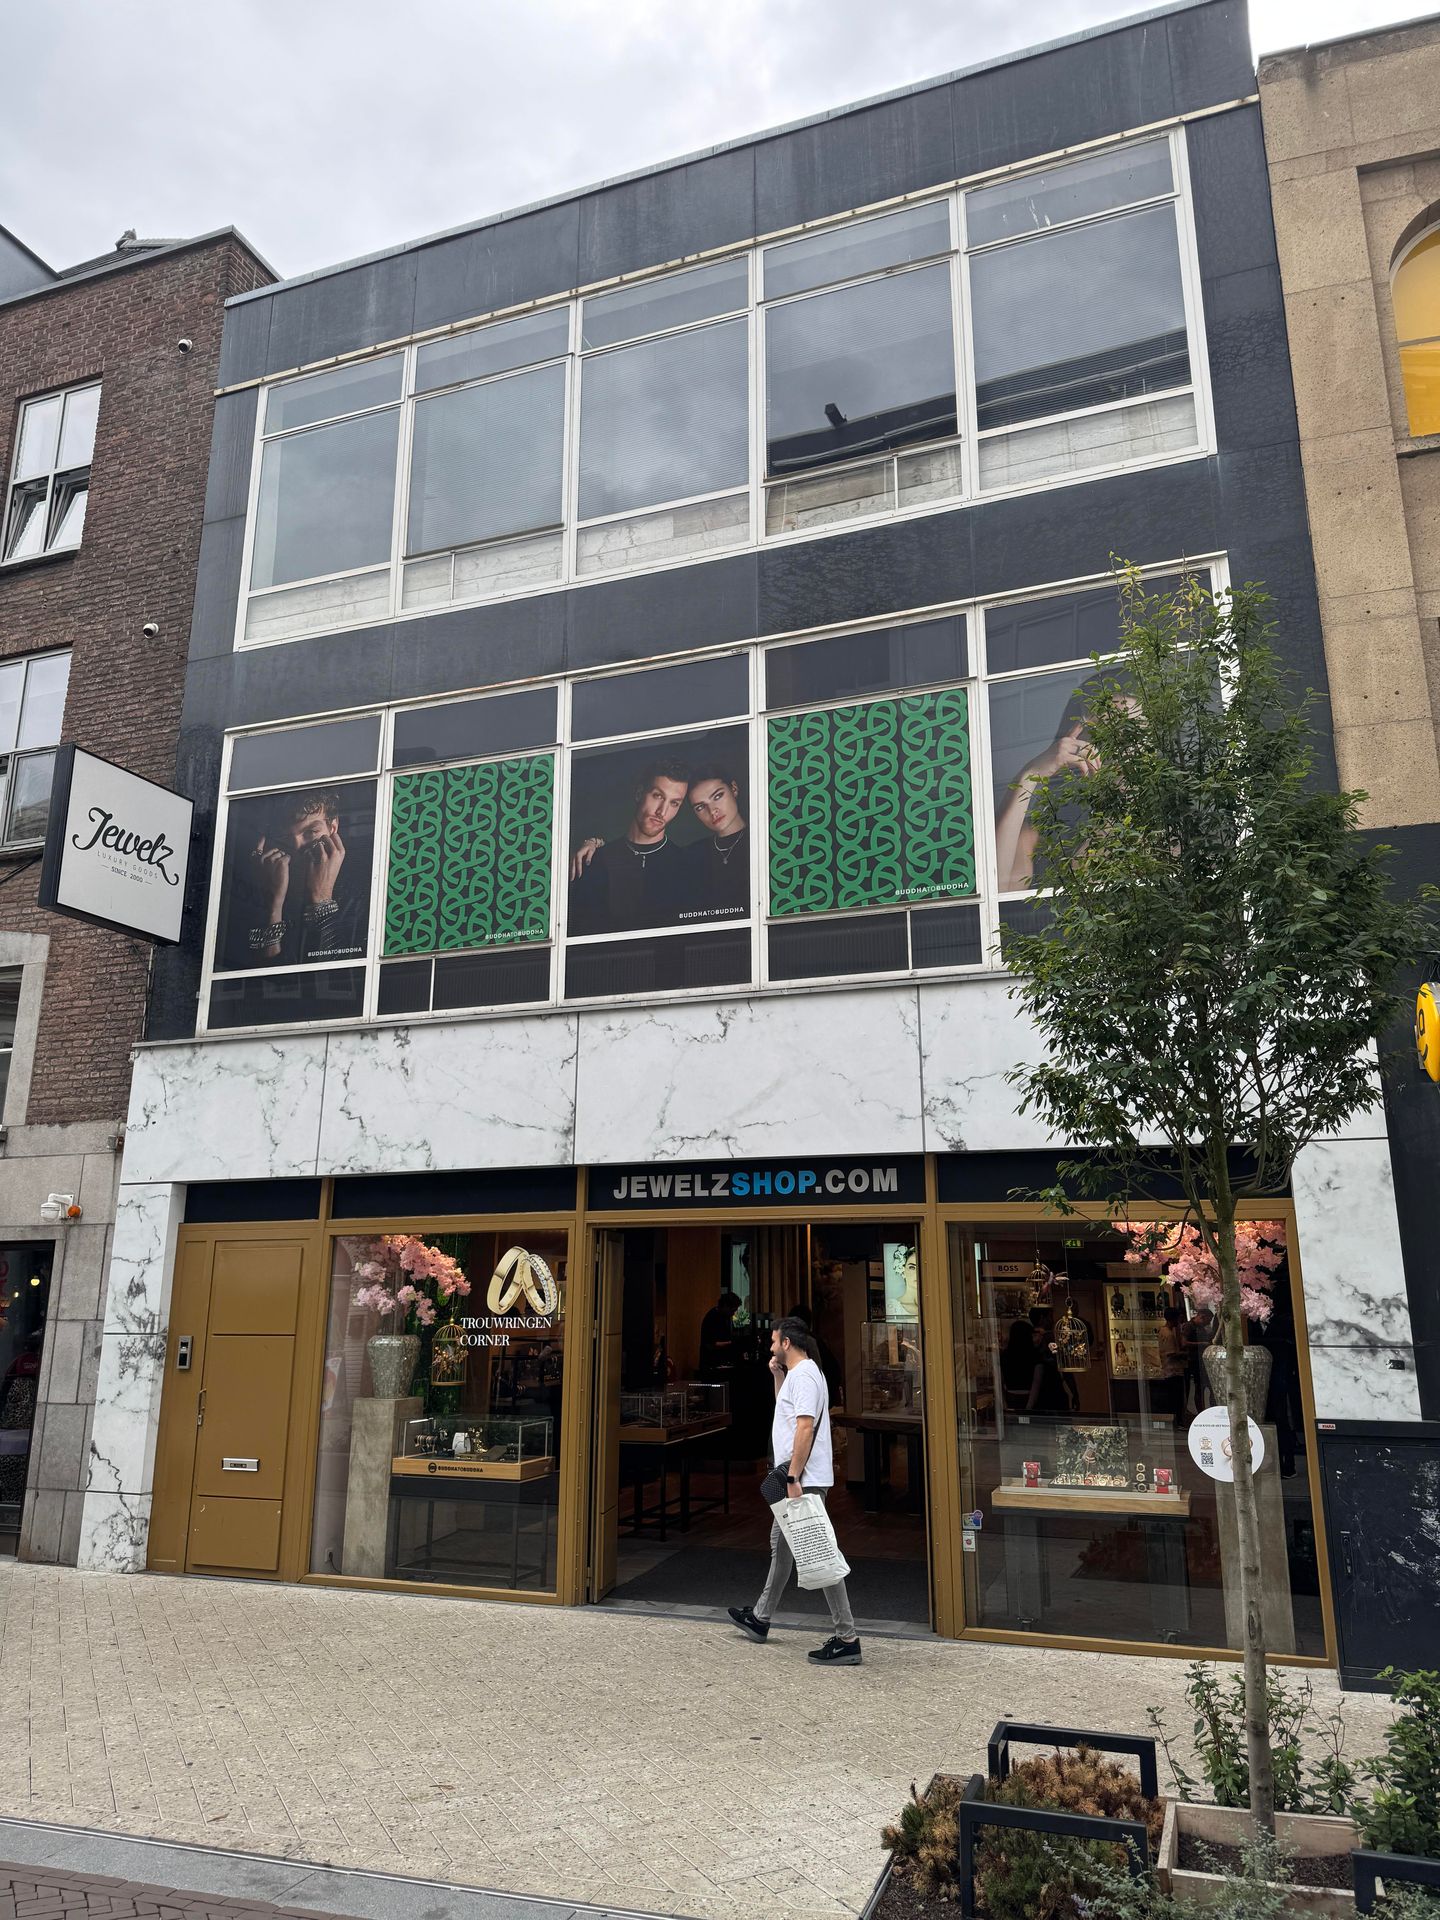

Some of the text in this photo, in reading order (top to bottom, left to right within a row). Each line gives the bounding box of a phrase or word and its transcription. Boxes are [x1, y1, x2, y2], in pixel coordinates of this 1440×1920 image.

[72, 807, 179, 886] Jewelz
[97, 850, 159, 879] LUXURY GOODS
[111, 866, 144, 883] SINCE 2000
[894, 882, 969, 895] BUDDHATOBUDDHA
[678, 906, 744, 919] BUDDHATOBUDDHA
[485, 929, 544, 940] BUDDHATOBUDDHA
[307, 947, 362, 957] BUDDHATOBUDDHA
[613, 1168, 898, 1199] JEWELZSHOP.COM
[460, 1317, 552, 1329] TROUWRINGEN
[460, 1334, 510, 1346] CORNER
